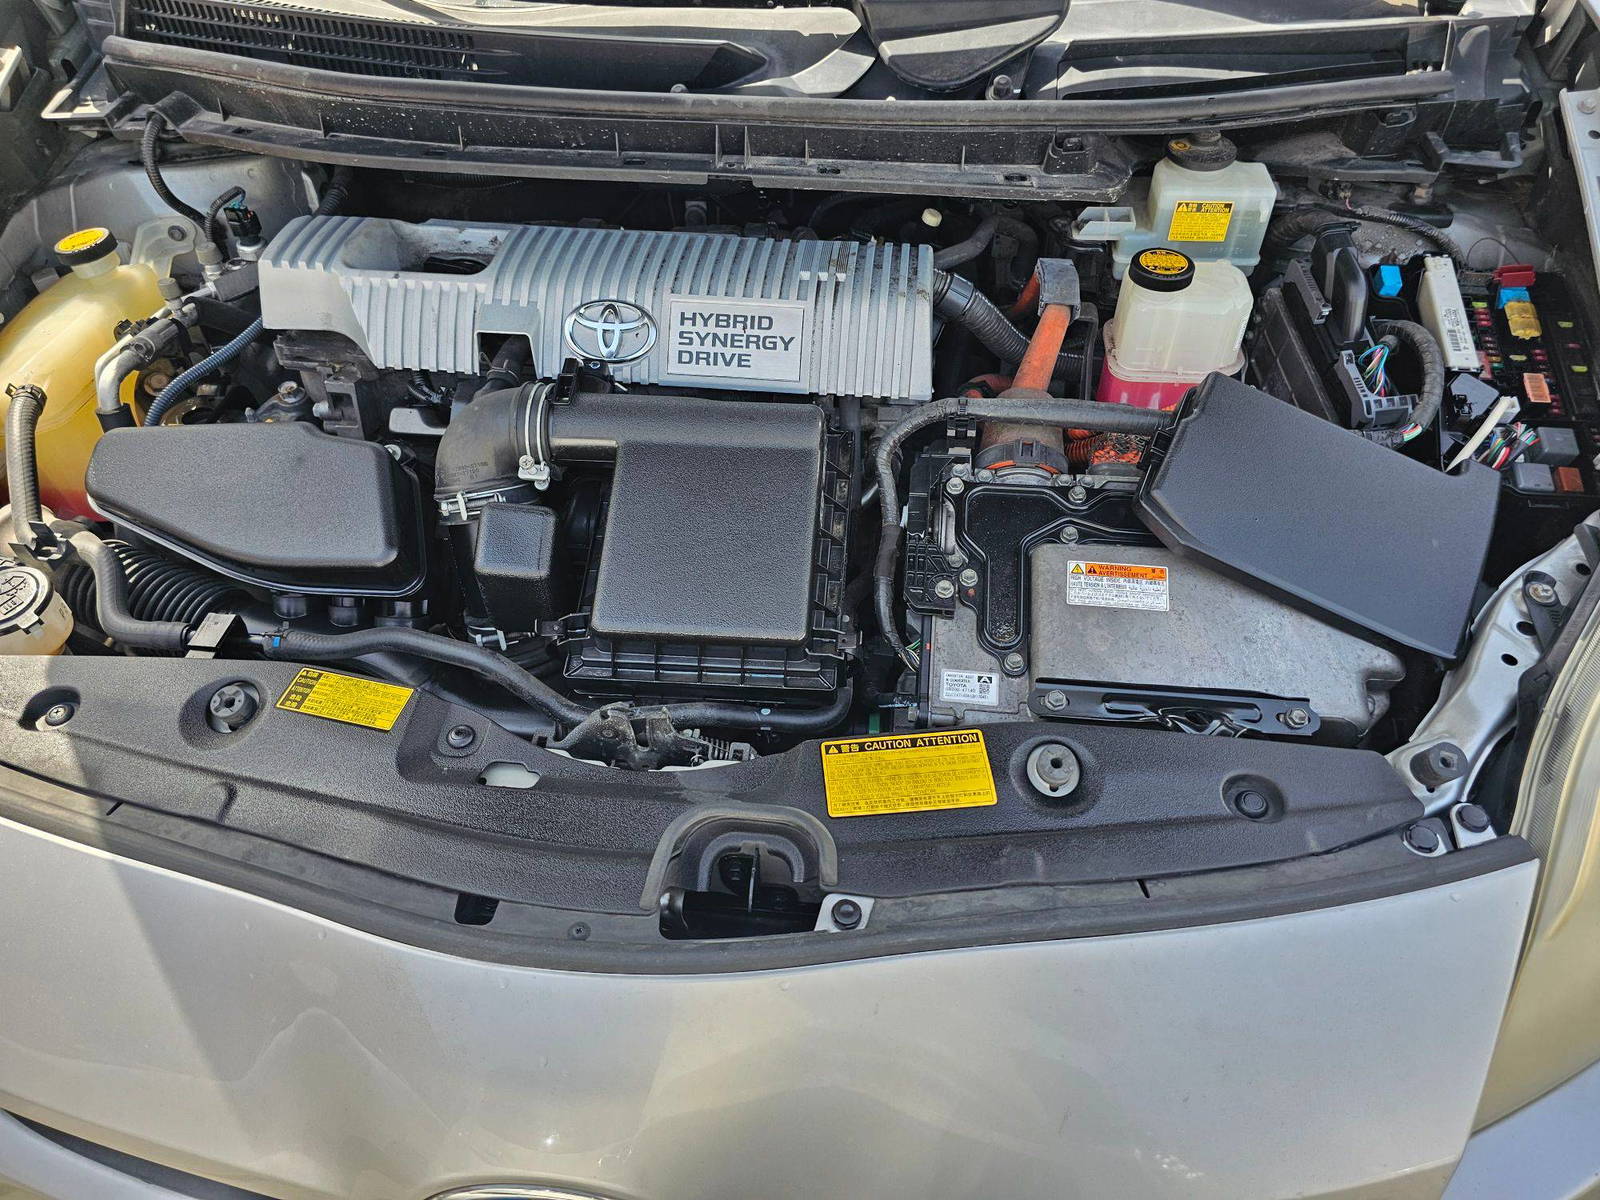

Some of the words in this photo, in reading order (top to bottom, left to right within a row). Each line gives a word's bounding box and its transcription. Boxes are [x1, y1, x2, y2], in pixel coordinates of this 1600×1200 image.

[680, 312, 774, 330] HYBRID
[678, 331, 796, 351] SYNERGY
[677, 350, 752, 368] DRIVE
[864, 739, 912, 751] CAUTION
[916, 733, 978, 747] ATTENTION
